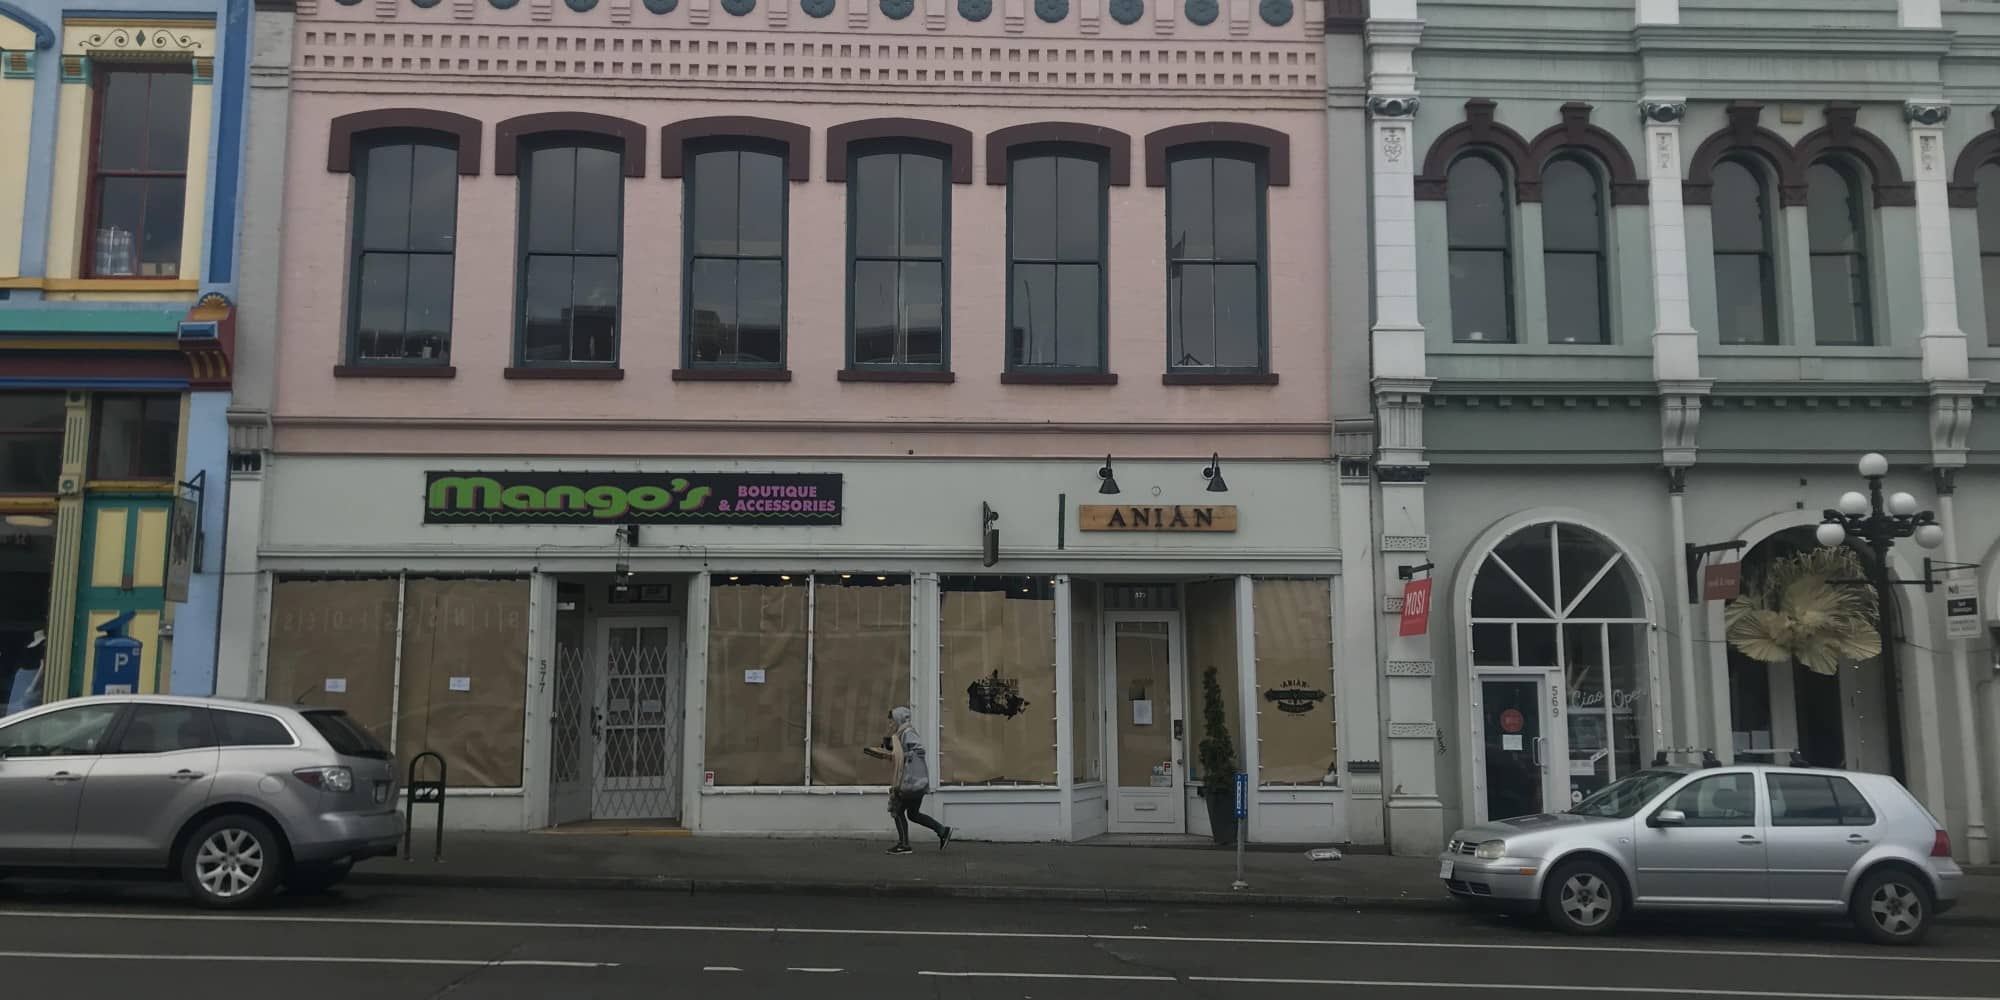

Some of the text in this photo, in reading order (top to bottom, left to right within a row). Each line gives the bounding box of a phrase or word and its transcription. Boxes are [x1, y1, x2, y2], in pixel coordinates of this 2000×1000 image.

[430, 477, 712, 517] Mango's
[738, 485, 817, 498] BOUTIQUE
[718, 499, 835, 512] & ACCESSORIES
[1551, 685, 1560, 719] 569
